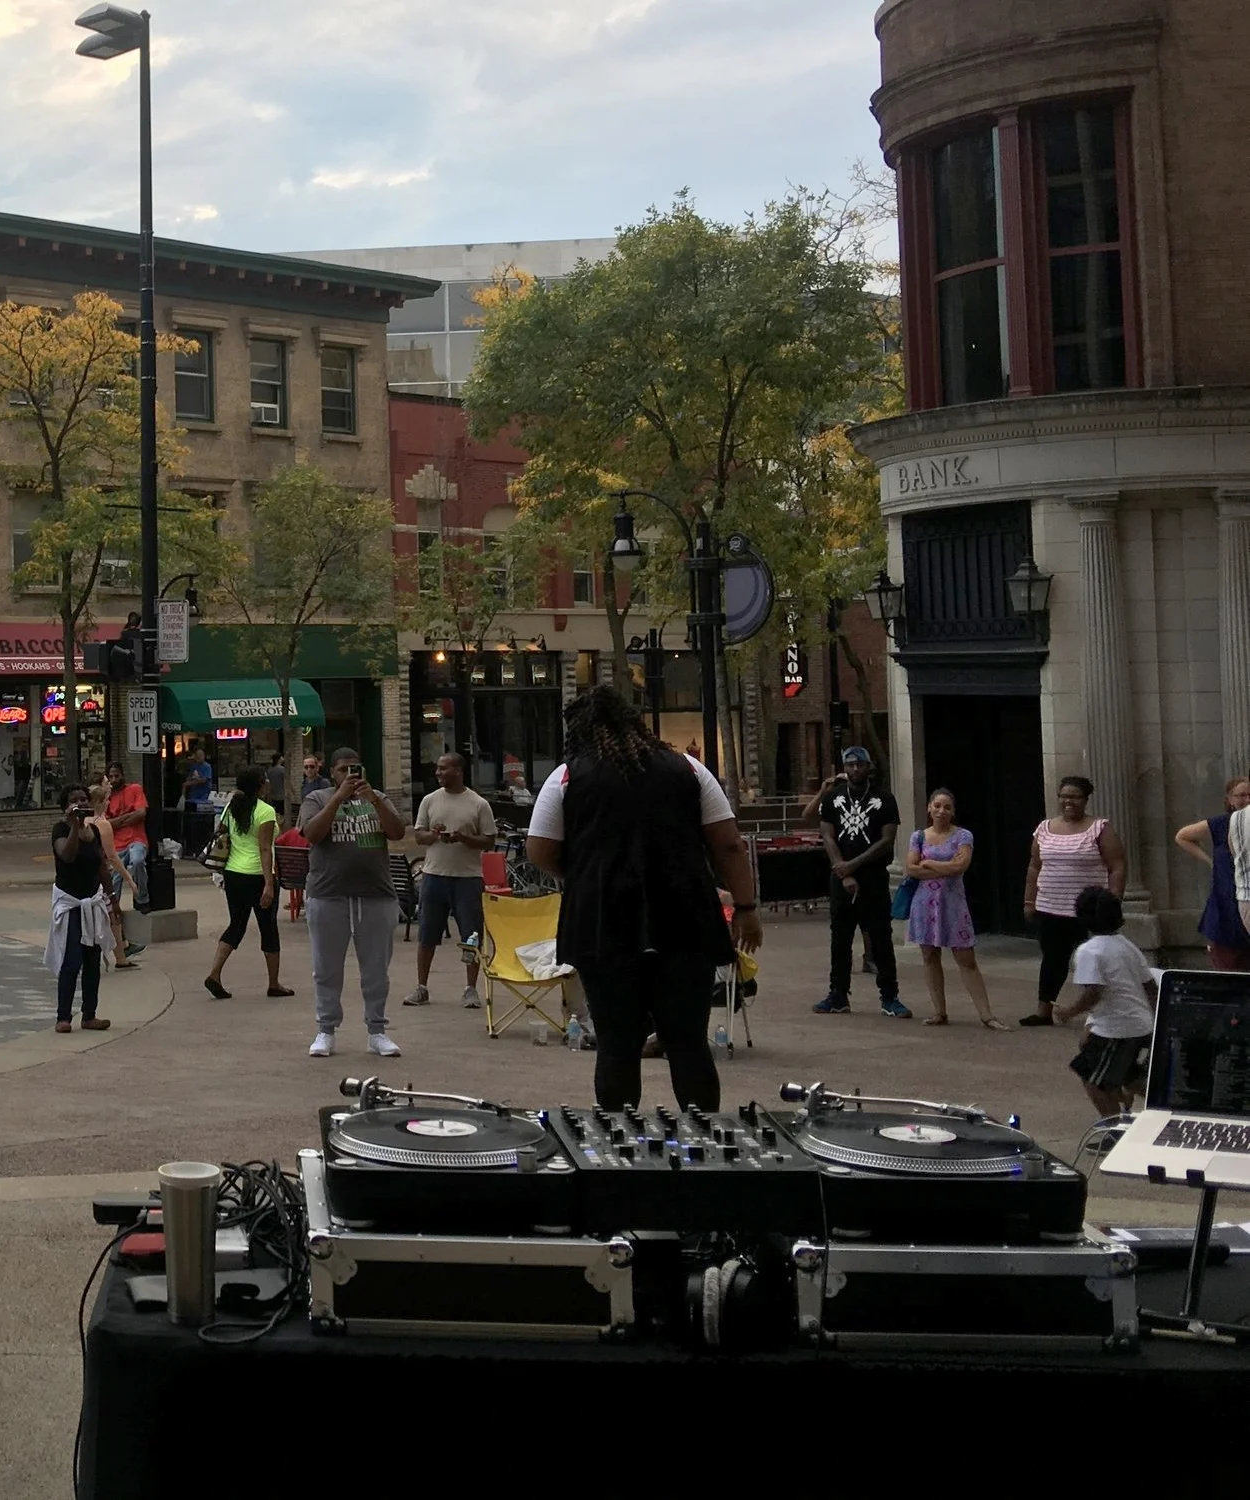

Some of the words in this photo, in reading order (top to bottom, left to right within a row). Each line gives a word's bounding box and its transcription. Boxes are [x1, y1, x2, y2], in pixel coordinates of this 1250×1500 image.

[11, 662, 51, 671] HOOKAHS
[130, 697, 155, 709] SPEED
[44, 707, 67, 723] OPE
[132, 711, 153, 723] LIMIT
[134, 725, 152, 748] 15
